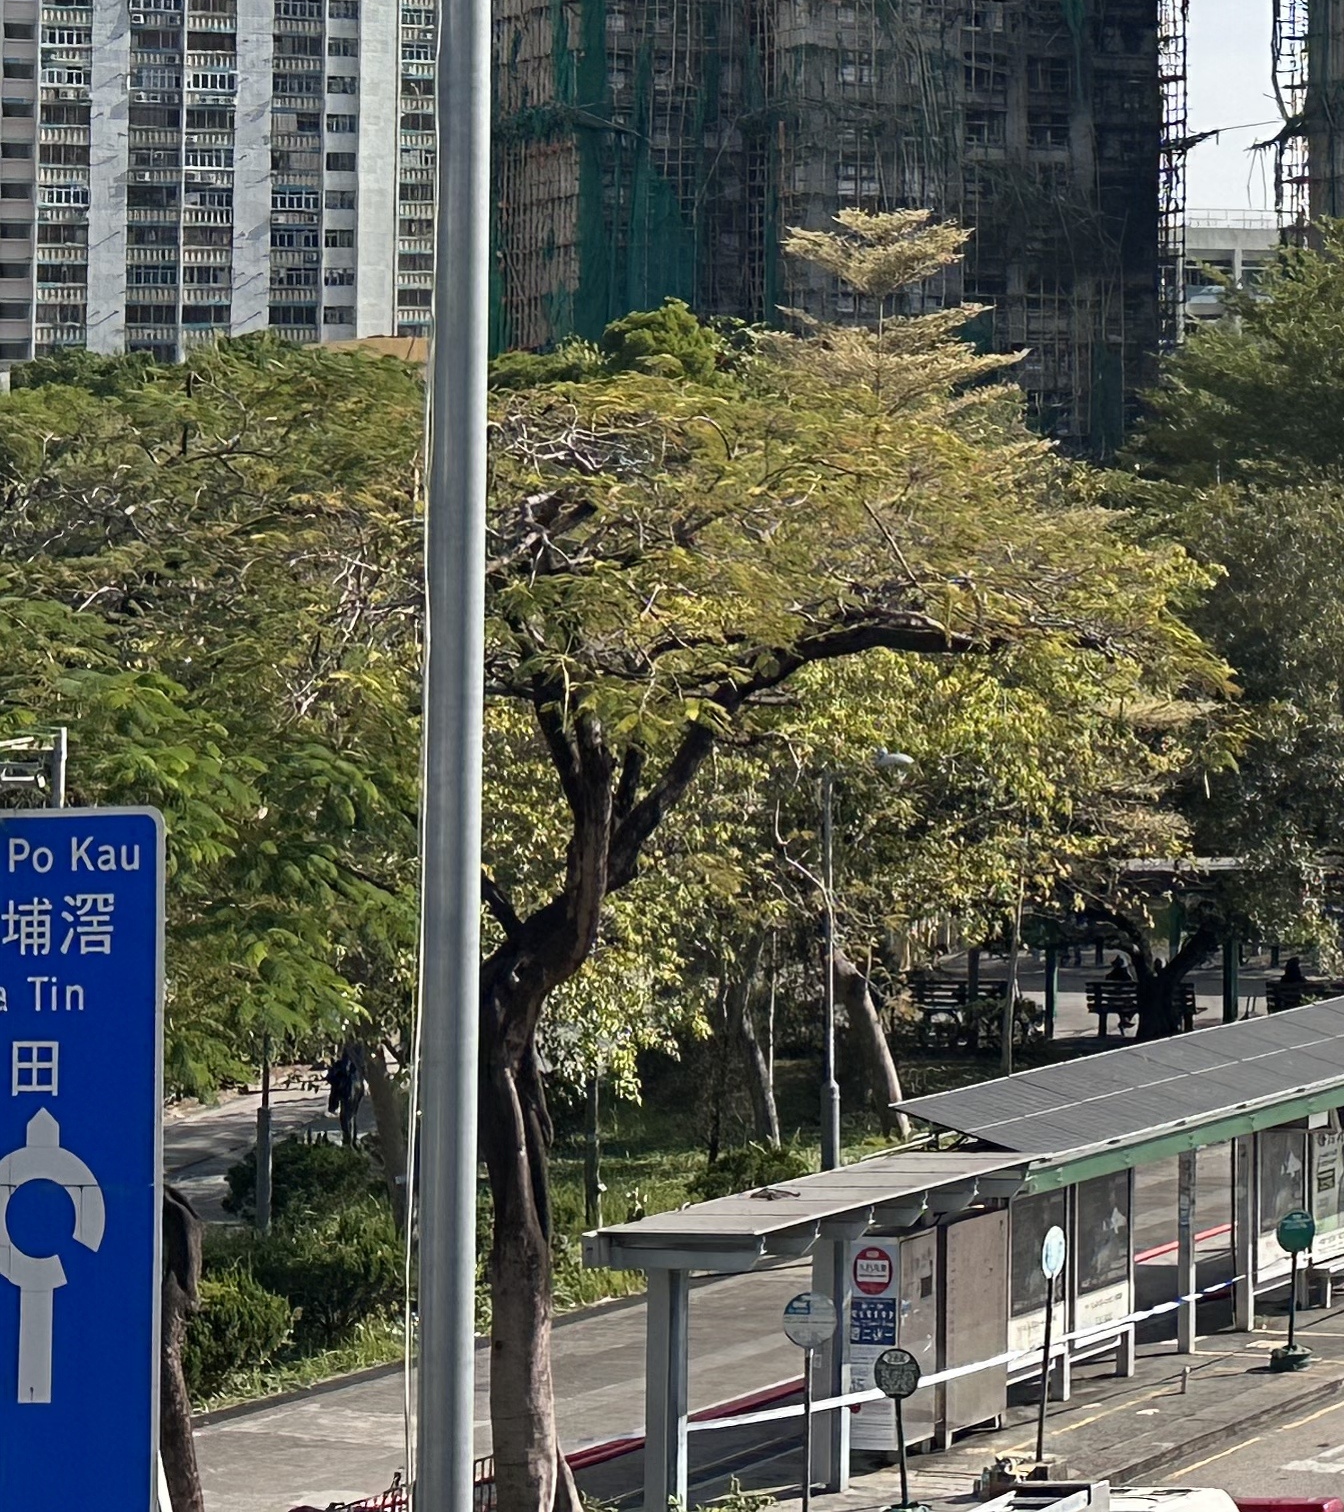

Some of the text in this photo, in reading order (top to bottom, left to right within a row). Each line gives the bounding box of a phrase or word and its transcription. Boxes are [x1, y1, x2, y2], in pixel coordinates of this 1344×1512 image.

[9, 837, 140, 873] Po Kau
[26, 976, 84, 1012] Tin
[12, 1040, 59, 1096] 田
